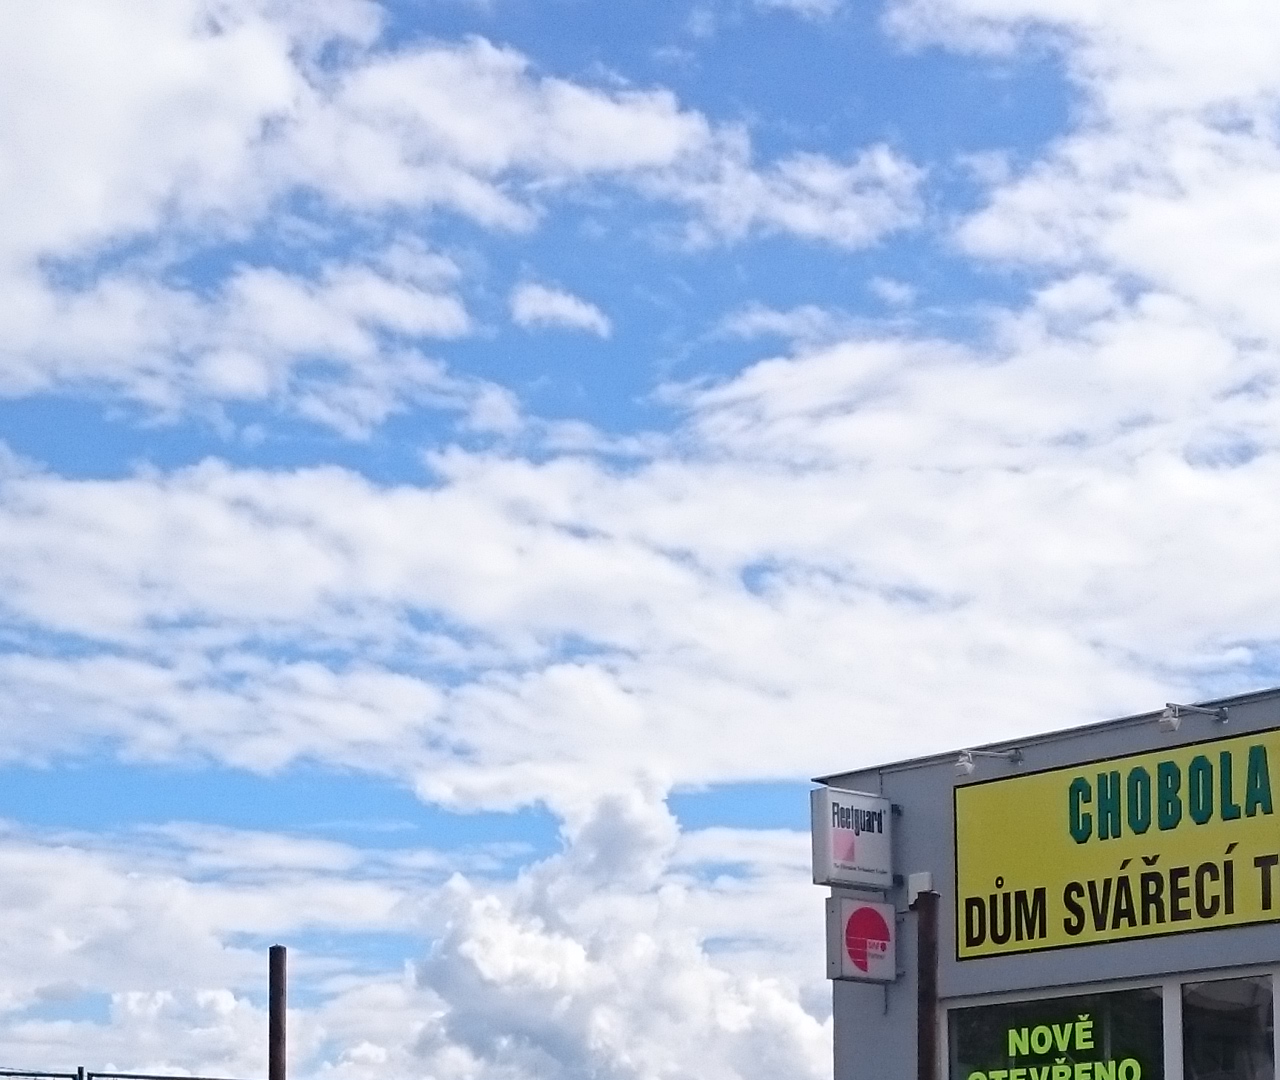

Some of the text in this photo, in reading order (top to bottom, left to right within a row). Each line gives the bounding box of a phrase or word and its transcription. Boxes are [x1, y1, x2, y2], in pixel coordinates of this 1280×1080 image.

[1069, 744, 1274, 844] CHOBOLA
[964, 876, 1048, 948] DŮM
[1063, 841, 1239, 936] SVÁŘECÍ
[1008, 1014, 1095, 1057] NOVĚ
